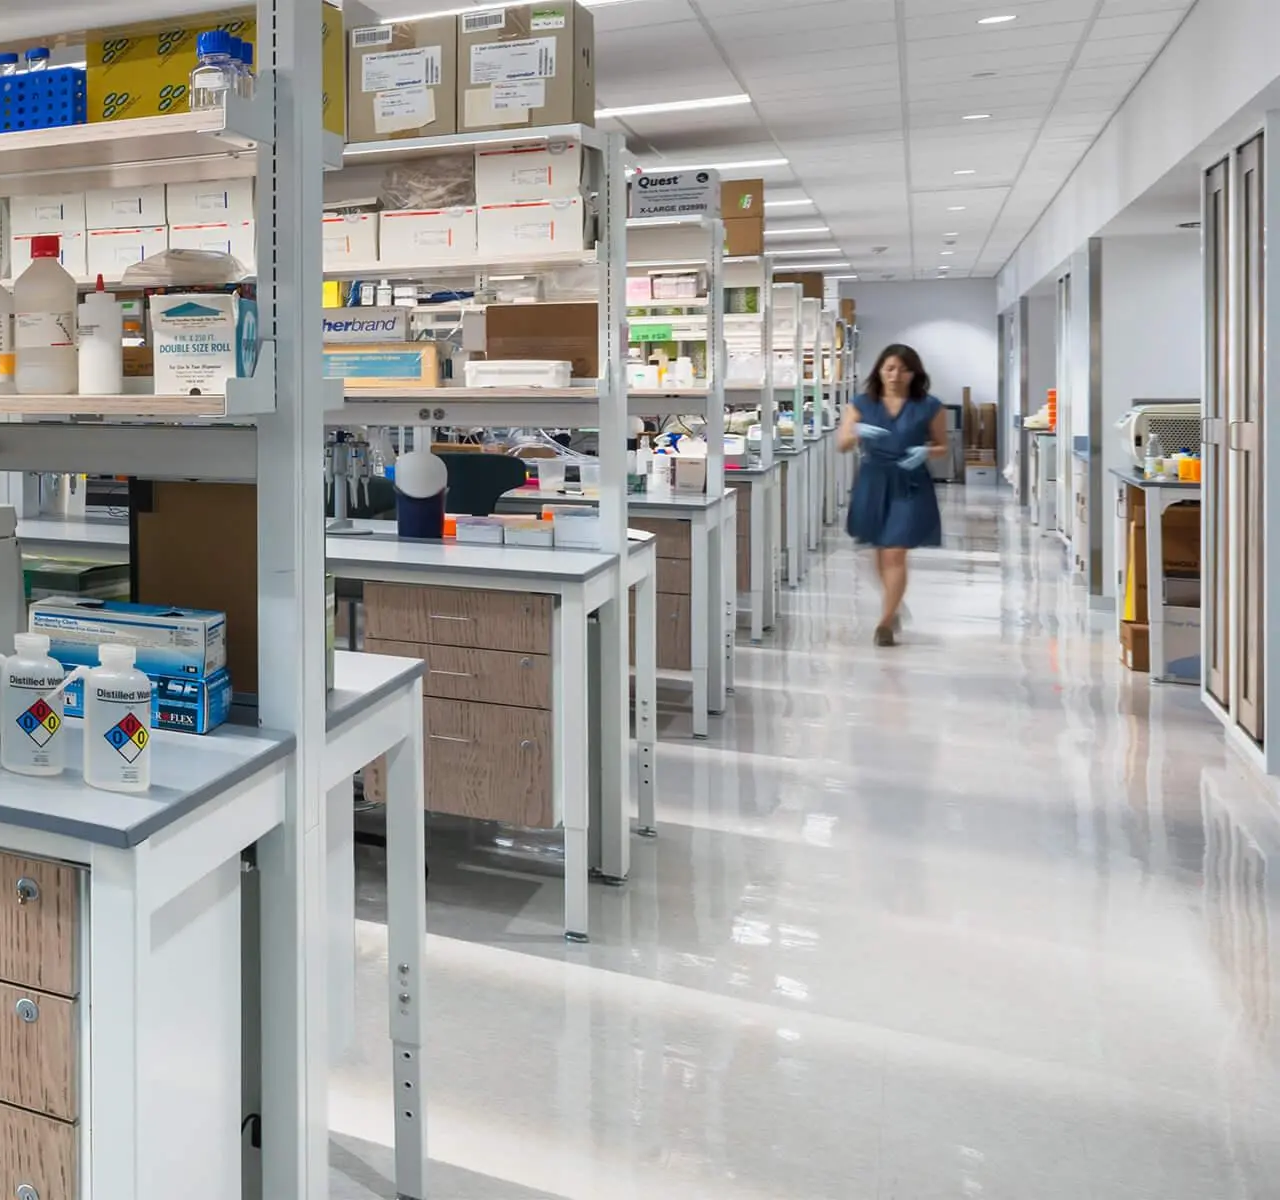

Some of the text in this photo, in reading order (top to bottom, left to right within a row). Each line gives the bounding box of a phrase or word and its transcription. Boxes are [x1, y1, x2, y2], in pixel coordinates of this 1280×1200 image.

[640, 205, 676, 214] X-LARGE
[322, 317, 397, 332] herbrand
[160, 343, 231, 353] DOUBLE SIZE ROLL
[10, 675, 45, 686] Distilled
[97, 688, 135, 700] Distilled
[37, 705, 45, 716] 0
[24, 716, 56, 729] 0 0
[126, 719, 134, 731] 0
[113, 731, 145, 744] 0 0
